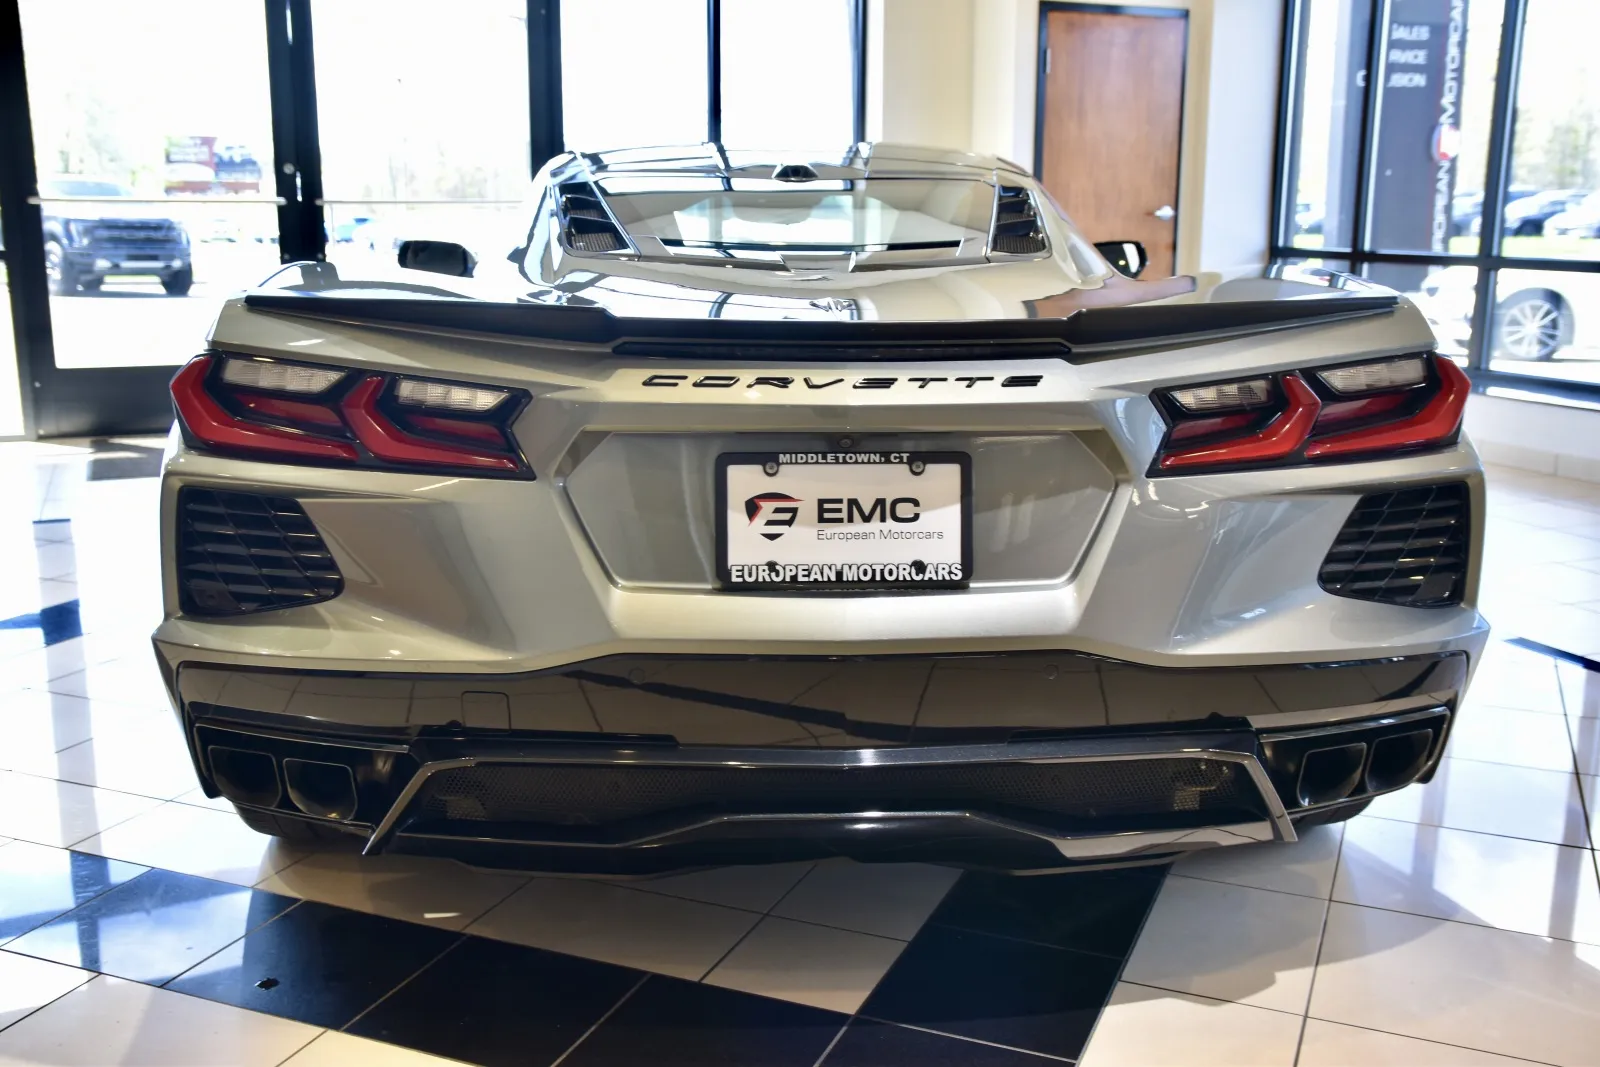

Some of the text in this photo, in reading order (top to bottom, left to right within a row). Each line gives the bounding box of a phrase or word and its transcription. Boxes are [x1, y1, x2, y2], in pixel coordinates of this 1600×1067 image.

[1388, 48, 1429, 65] RVICE
[1430, 161, 1450, 255] ROPEAN
[642, 375, 1043, 389] CORVETTE
[778, 453, 910, 464] MIDDLETOWN, CT
[817, 498, 921, 524] EMC
[816, 529, 944, 543] European Motorcars
[730, 564, 837, 582] EUROPEAN
